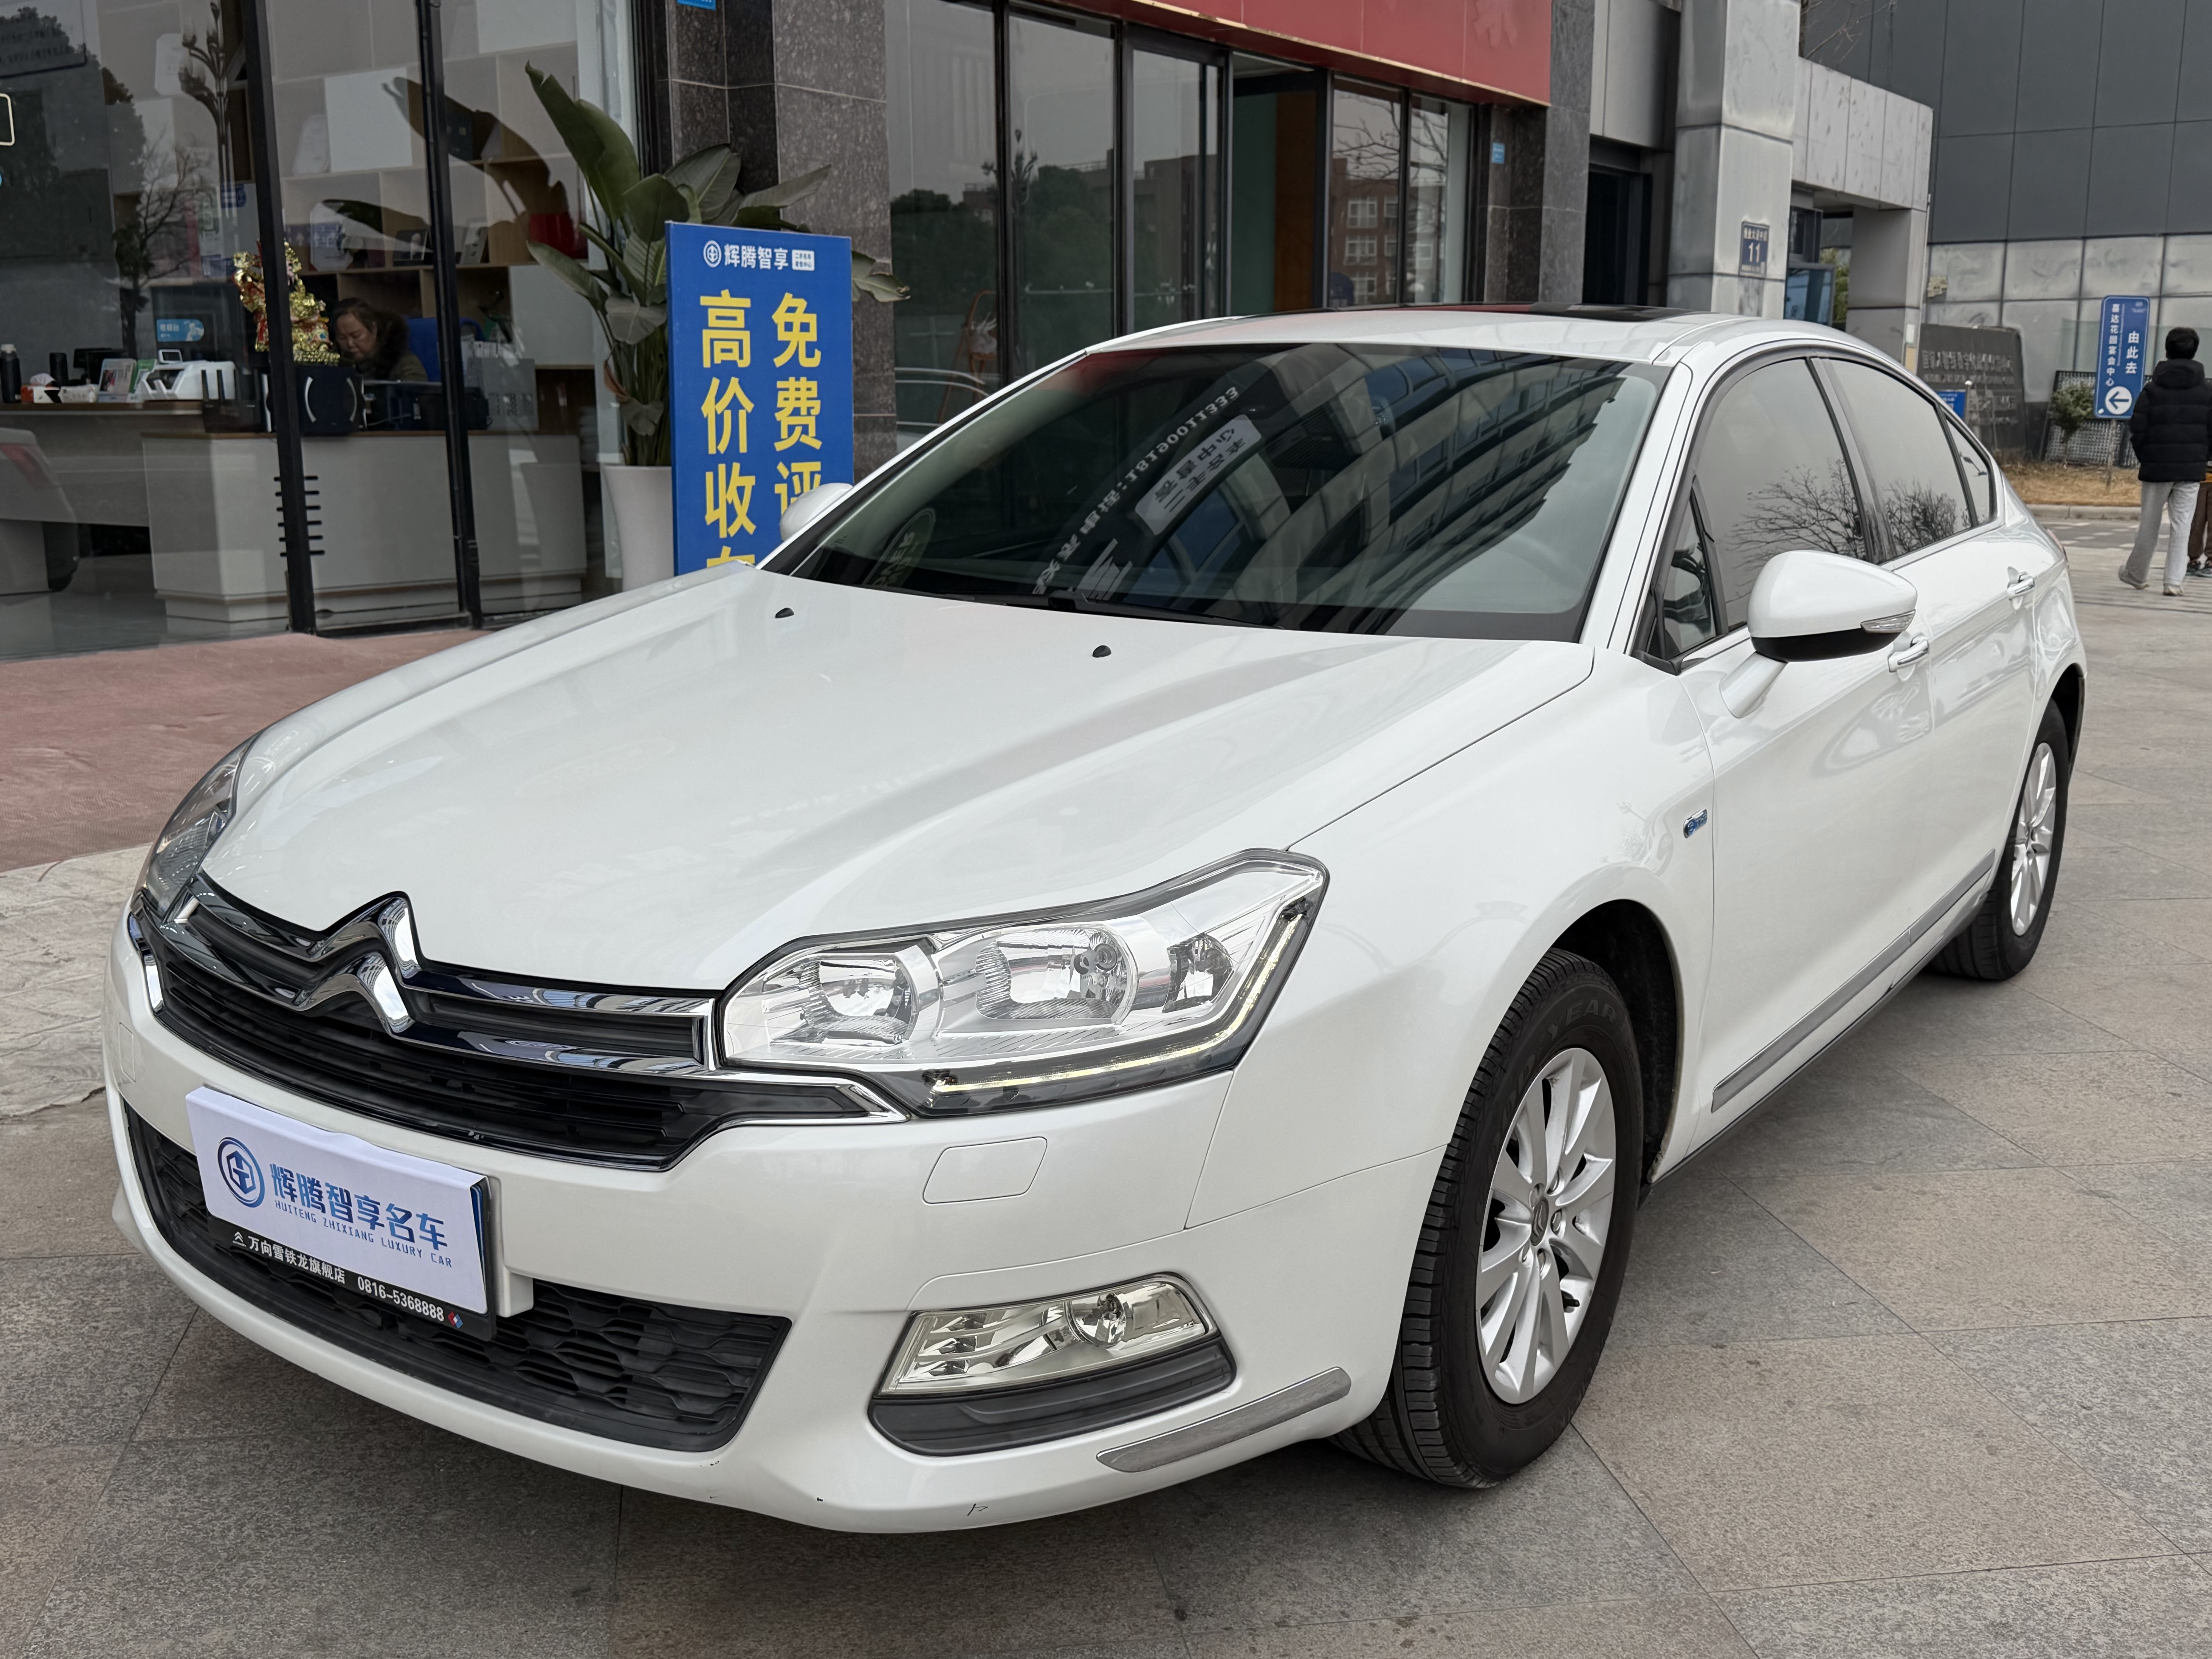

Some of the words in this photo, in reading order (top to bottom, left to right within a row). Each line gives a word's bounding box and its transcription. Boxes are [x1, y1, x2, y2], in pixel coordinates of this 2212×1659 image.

[724, 244, 789, 271] 辉腾智享
[1748, 242, 1760, 263] 11
[2125, 330, 2140, 374] 由此去
[269, 1163, 448, 1249] 辉腾智享名车
[275, 1199, 317, 1223] HUITENG
[323, 1217, 374, 1243] ZHIXIANG
[381, 1237, 423, 1258] LUXURY
[430, 1252, 453, 1268] CAR
[248, 1235, 346, 1285] 万向雪铁龙旗舰店
[357, 1276, 445, 1322] 0816-5368888
